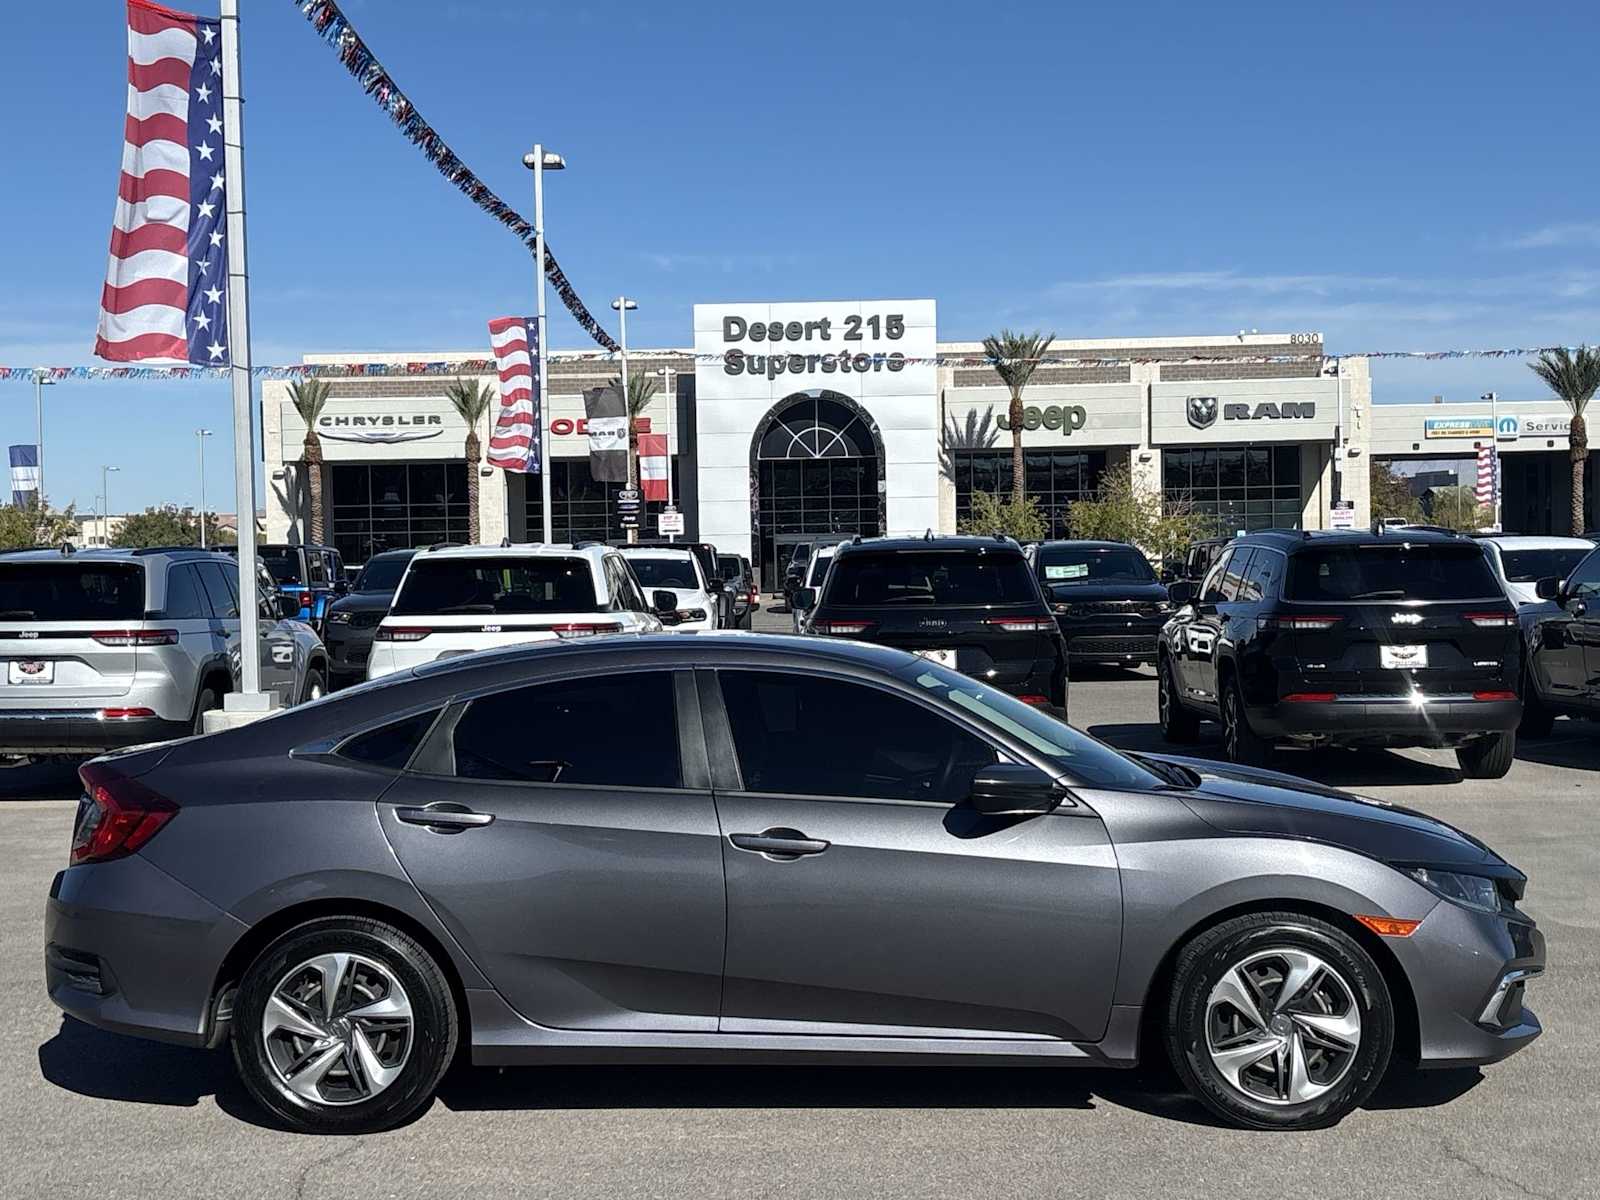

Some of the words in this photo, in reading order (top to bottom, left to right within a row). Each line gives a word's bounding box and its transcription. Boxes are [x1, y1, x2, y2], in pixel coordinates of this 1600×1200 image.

[723, 316, 831, 342] Desert
[844, 314, 905, 341] 215
[1290, 333, 1319, 344] 8030
[723, 348, 906, 381] Superstore
[1223, 402, 1316, 420] RAM
[319, 415, 442, 427] CHRYSLER
[1526, 421, 1573, 432] Servic
[481, 624, 502, 633] Jeep
[18, 630, 39, 640] Jeep
